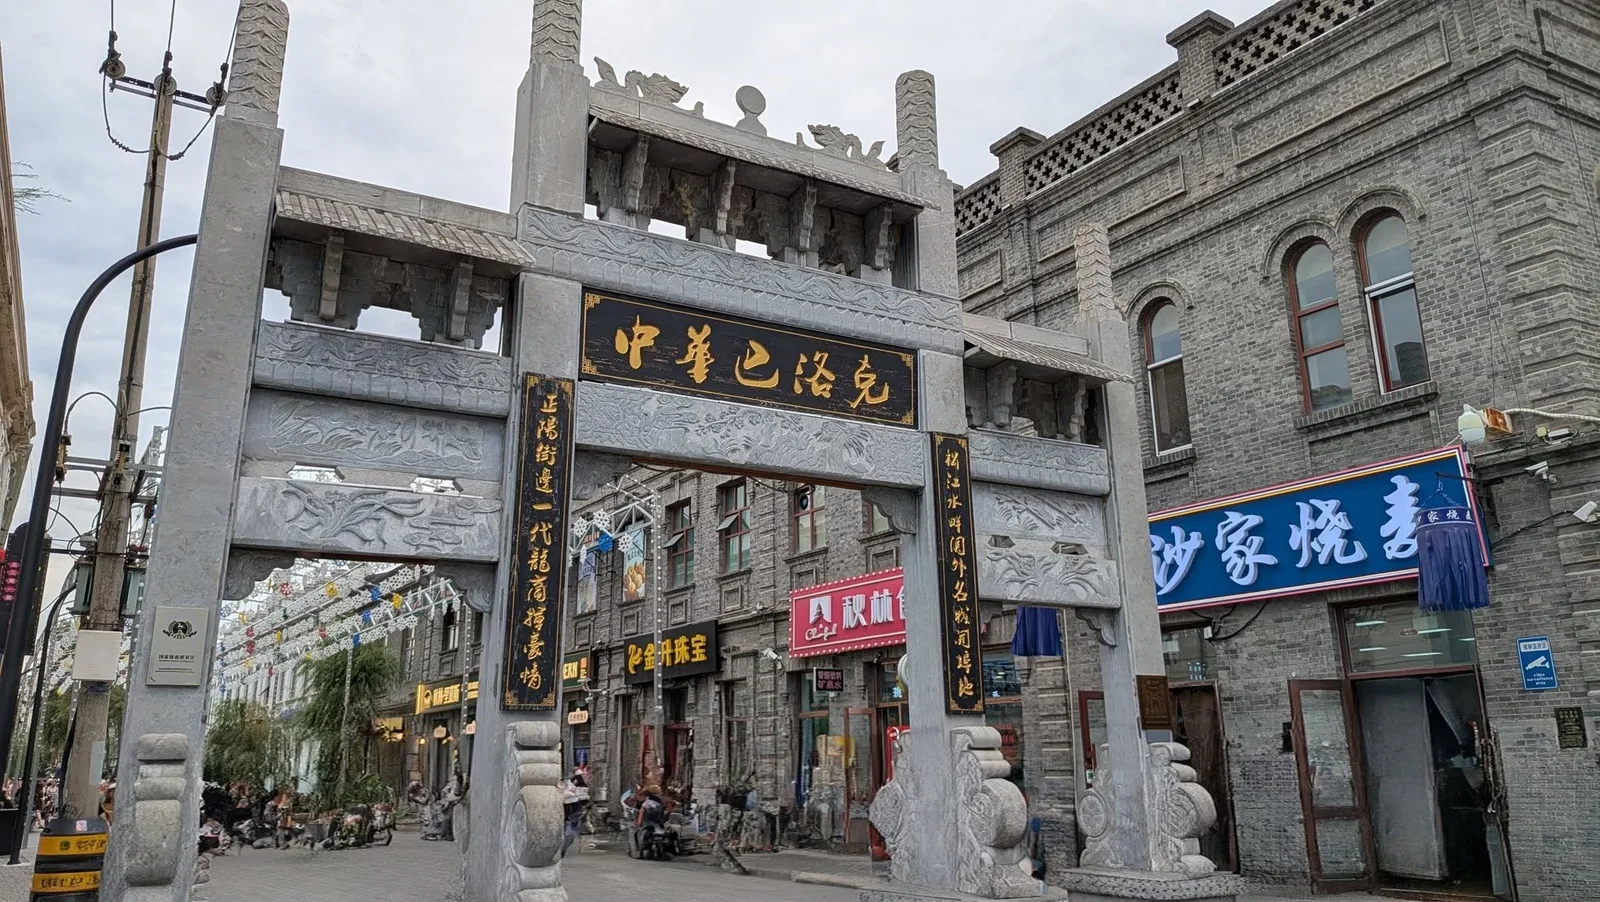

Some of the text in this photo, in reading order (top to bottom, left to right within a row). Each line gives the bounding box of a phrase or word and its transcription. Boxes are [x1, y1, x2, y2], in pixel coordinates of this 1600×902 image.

[615, 315, 890, 409] 中華巴洛克
